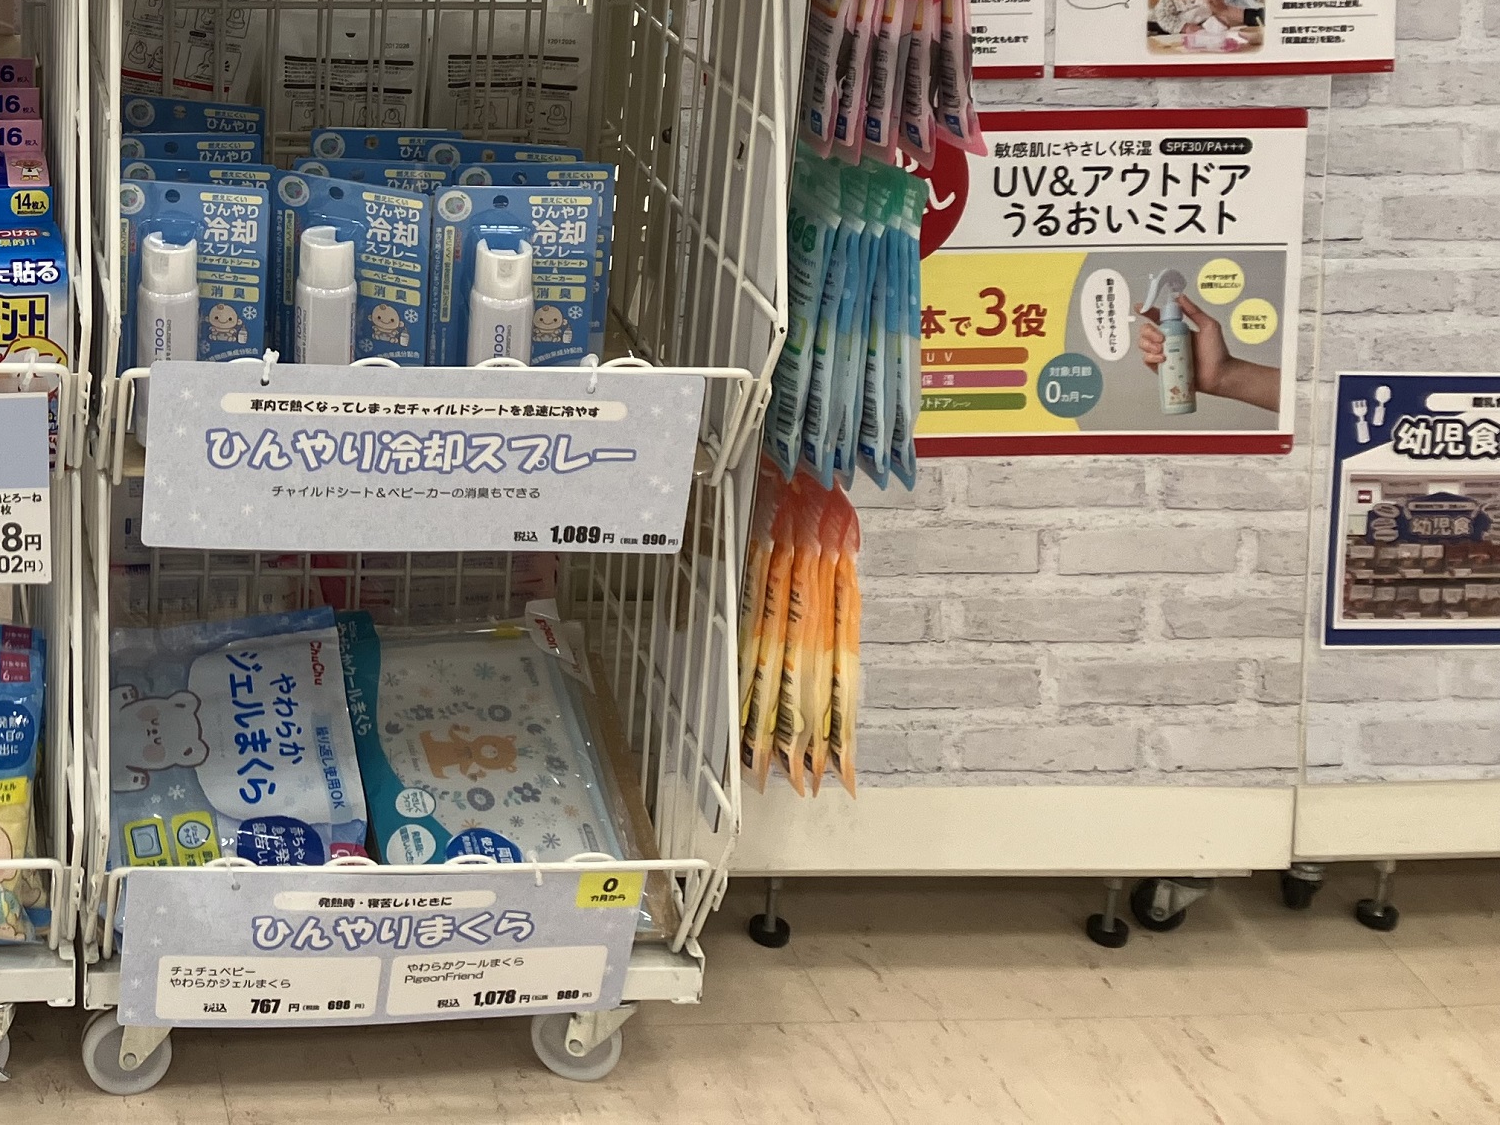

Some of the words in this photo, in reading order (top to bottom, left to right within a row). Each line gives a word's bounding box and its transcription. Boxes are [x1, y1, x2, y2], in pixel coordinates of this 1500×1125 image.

[994, 140, 1153, 159] 敏感肌にやさしく保湿
[1165, 140, 1245, 153] SPF30/PA+++
[992, 163, 1251, 198] UV＆アウトドア
[203, 202, 259, 219] ひんやり
[1003, 200, 1238, 237] うるおいミスト
[204, 217, 258, 244] 冷却
[202, 241, 258, 256] スプレー
[1106, 278, 1117, 354] 動き回る赤ちゃんにも
[1049, 366, 1092, 378] 対象月齢
[250, 398, 600, 418] 車内で熱くなってしまったチャイルドシートを急速に冷やす
[206, 429, 636, 474] ひんやり冷却スプレー
[271, 484, 541, 501] チャイルドシート＆ベビーカーの消臭もできる
[310, 640, 324, 686] ChuChu
[225, 650, 277, 806] ジェルまくら
[269, 673, 302, 764] やわらか
[252, 911, 534, 950] ひんやりまくら
[170, 965, 256, 977] チュチュベビー
[407, 956, 524, 972] やわらかクールまくら
[170, 976, 291, 990] やわらかジェルまくら
